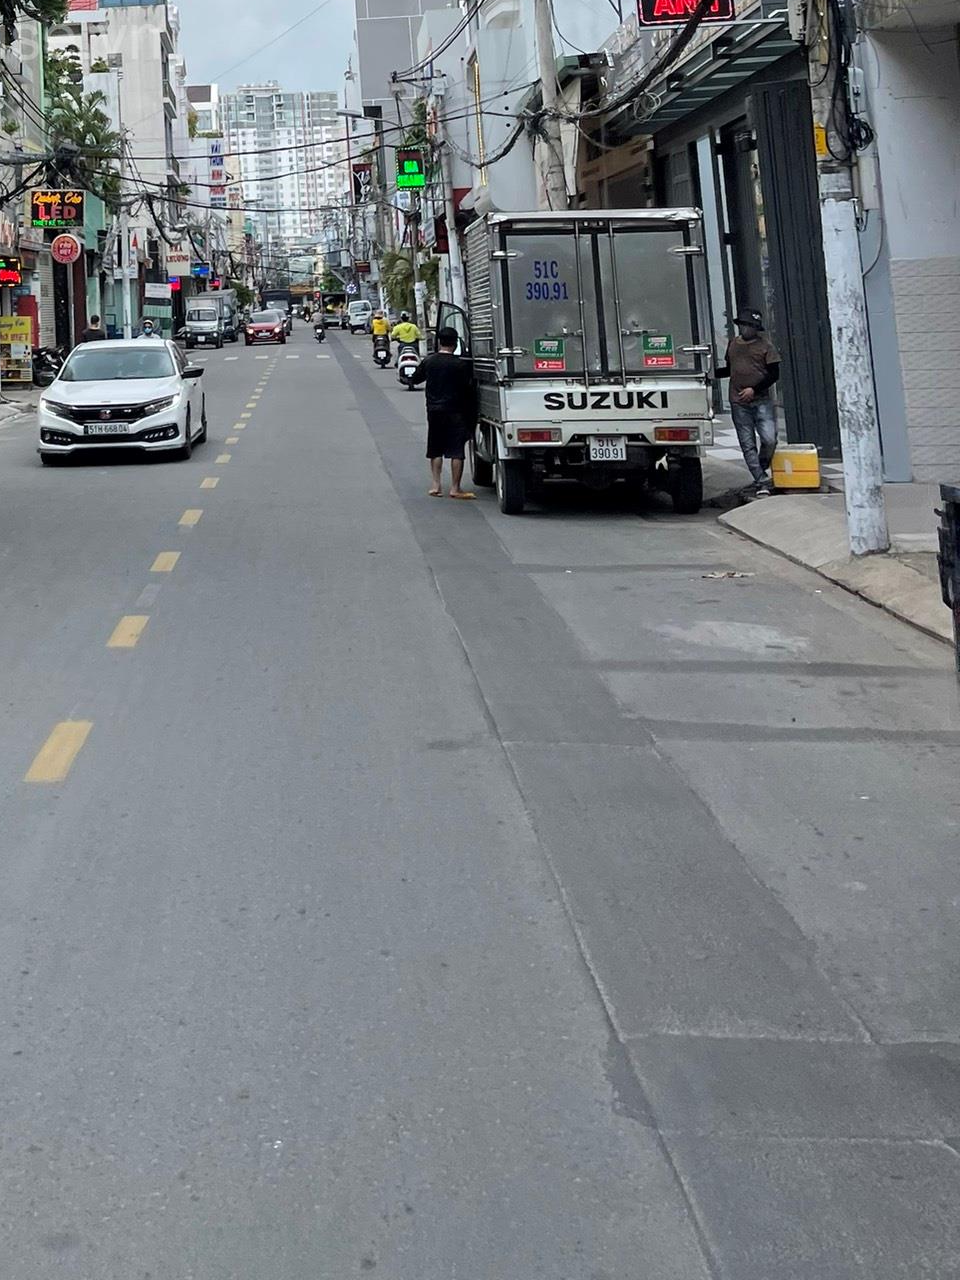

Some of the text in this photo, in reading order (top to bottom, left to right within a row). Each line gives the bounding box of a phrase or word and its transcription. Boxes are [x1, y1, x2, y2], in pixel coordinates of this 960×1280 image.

[38, 206, 77, 219] LED
[534, 261, 558, 279] 51C
[526, 282, 569, 301] 390.91
[543, 391, 669, 411] SUZUKI
[591, 447, 625, 460] 390.91
